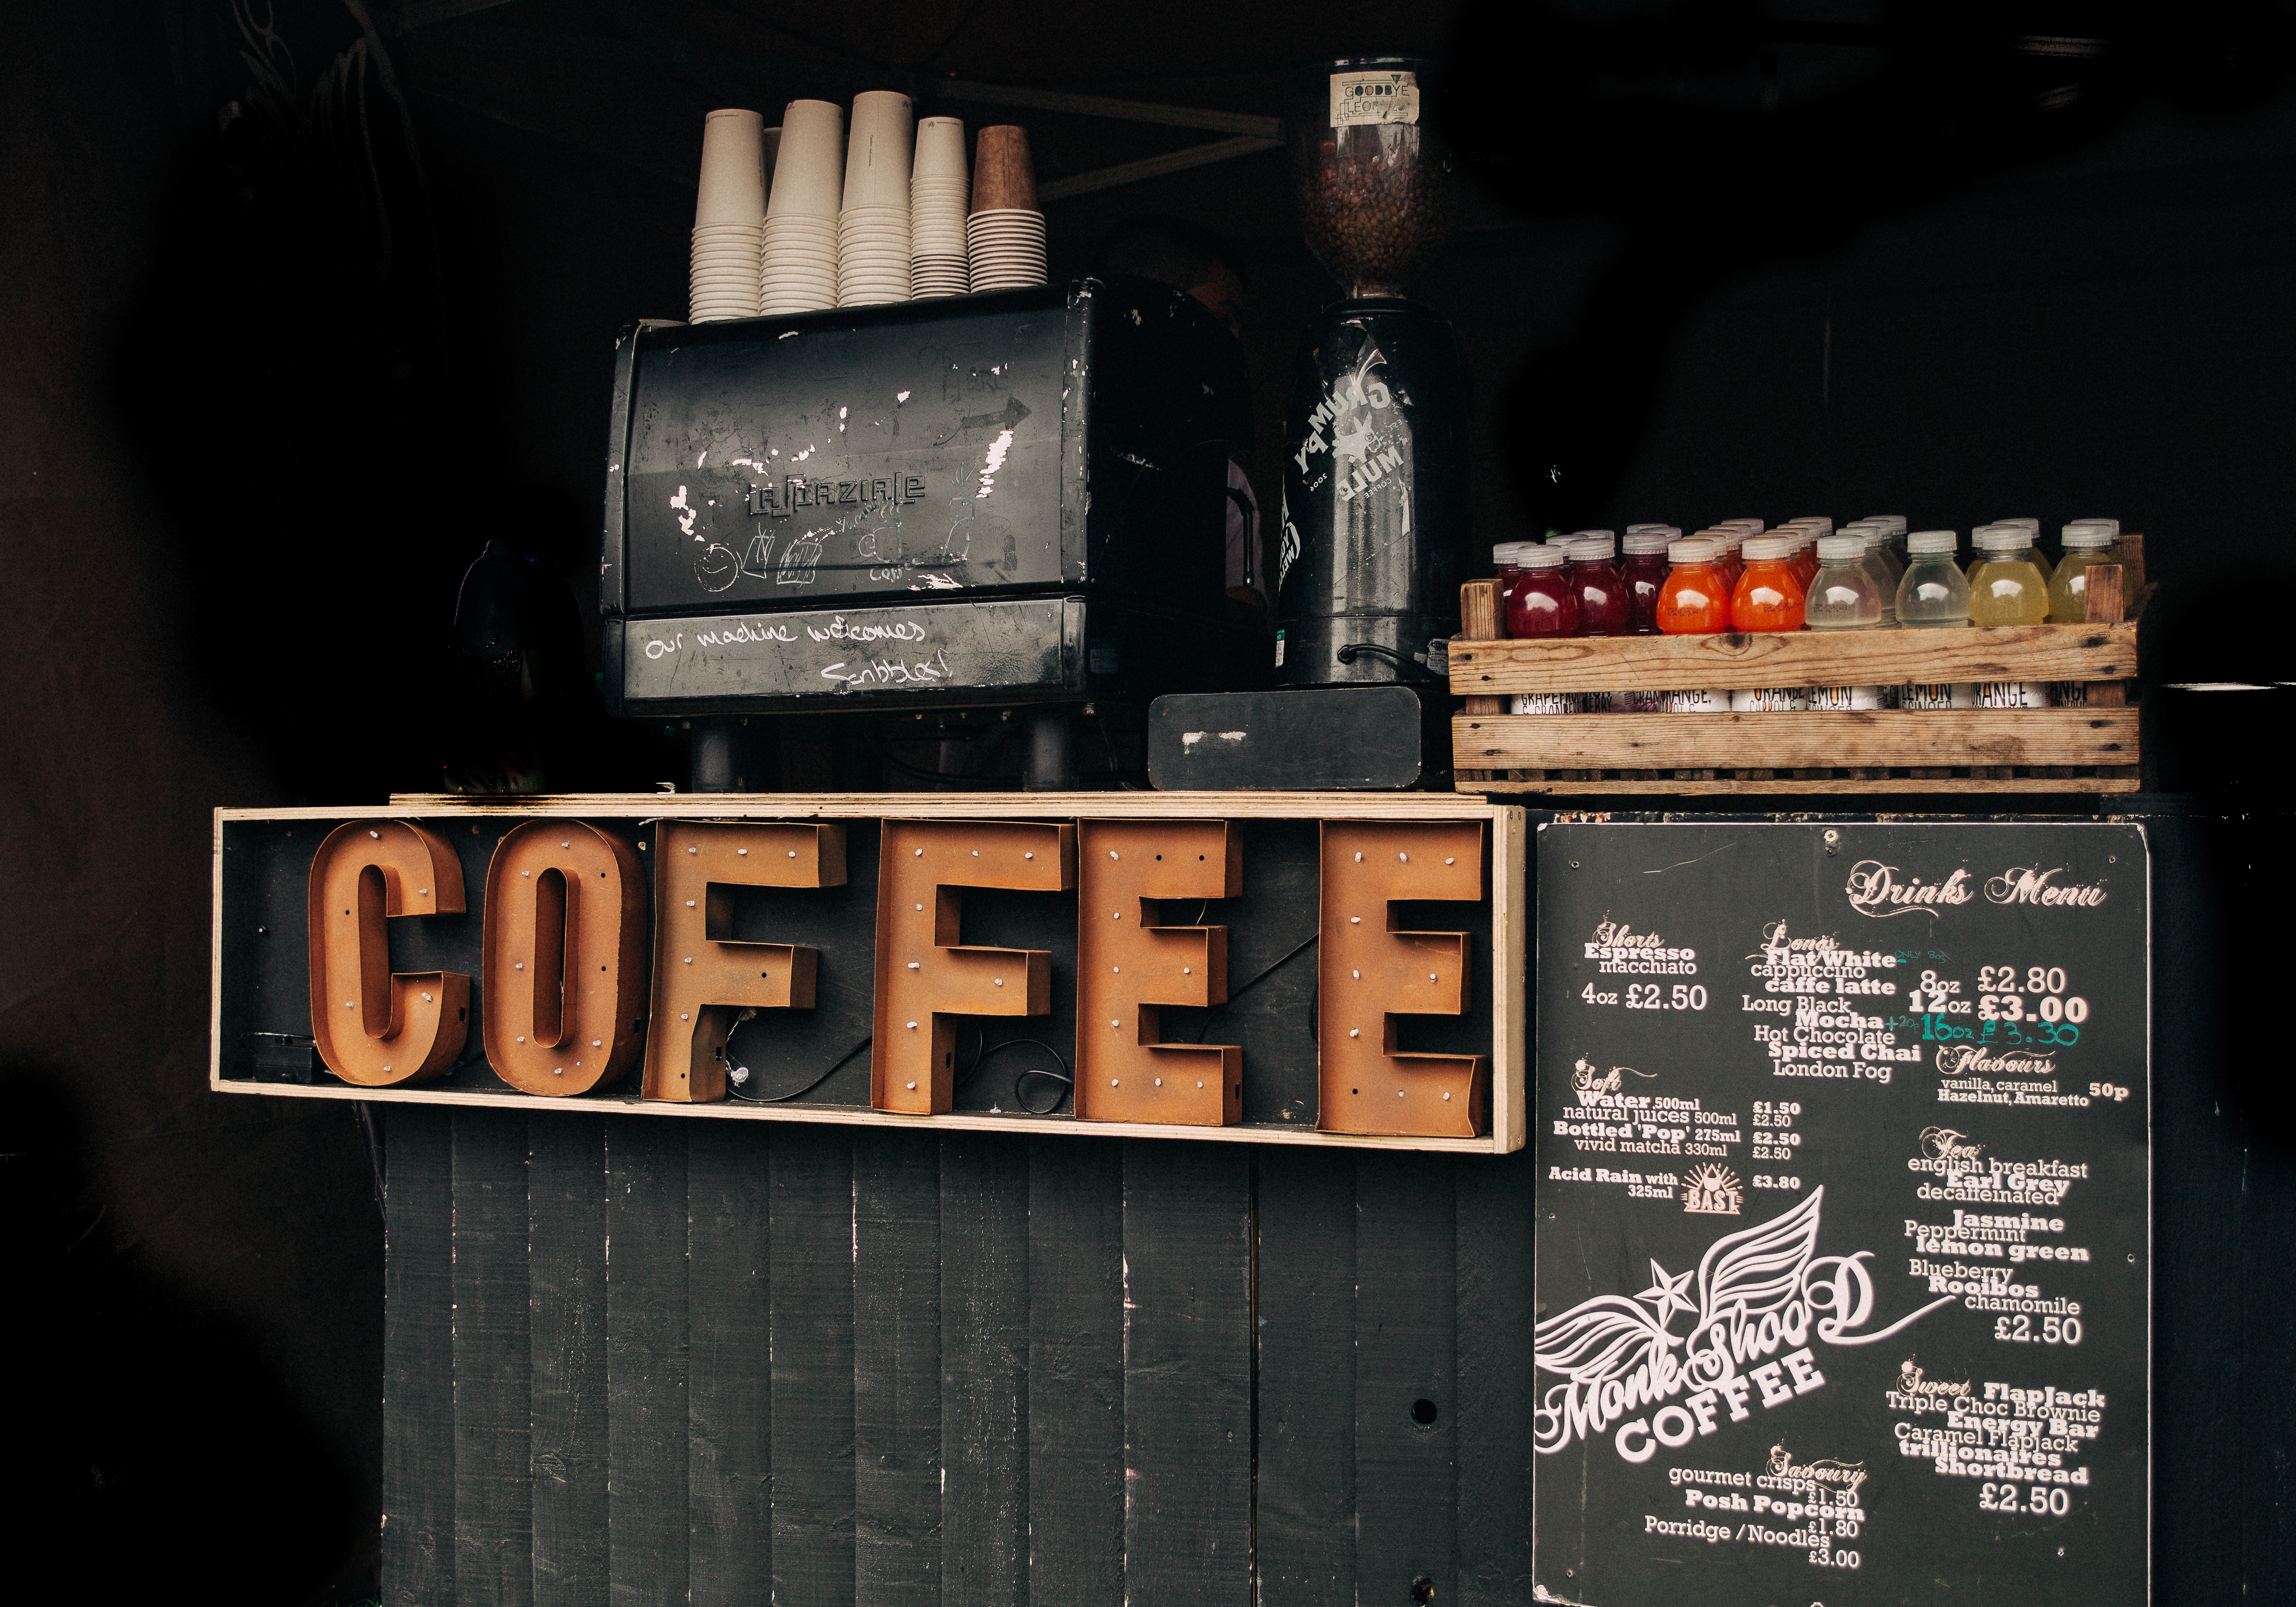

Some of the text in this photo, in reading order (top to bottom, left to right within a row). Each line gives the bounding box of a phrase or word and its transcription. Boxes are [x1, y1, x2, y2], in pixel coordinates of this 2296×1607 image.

[697, 622, 798, 647] machine
[807, 616, 926, 642] welcomes
[1845, 860, 2108, 916] Drinks Menu
[1592, 916, 1665, 948] Shorts
[1584, 943, 1695, 963] Espresso
[1599, 957, 1697, 974] macchiato
[1766, 950, 1898, 968] Flat White
[1895, 950, 1920, 959] ONLY
[309, 817, 1489, 1138] COFFEE
[1750, 964, 1866, 981] cappuccino
[1920, 966, 2066, 994] 8oz £2.80
[1581, 982, 1707, 1010] 4oz £2.50
[1765, 977, 1896, 995] caffe latte
[1742, 995, 1852, 1016] Long Black
[1909, 990, 2088, 1023] 12oz £3.00
[1795, 1010, 1884, 1029] Mocha
[1921, 1014, 1975, 1040] 16oz
[1754, 1025, 1895, 1045] Hot Chocolate
[1768, 1041, 1921, 1062] Spiced Chai
[1936, 1045, 2056, 1075] Flavours
[1571, 1059, 1642, 1096] Soft
[1773, 1060, 1892, 1084] London Fog
[1941, 1077, 2057, 1093] vanilla, caramel
[1577, 1090, 1802, 1115] Water 500ml £1.50
[1937, 1089, 2089, 1106] Hazelnut, Amaretto
[2089, 1083, 2128, 1100] 50p
[1563, 1105, 1791, 1127] natural juices 500ml £2.50
[1553, 1121, 1633, 1138] Bottled
[1695, 1128, 1741, 1142] 275ml
[1752, 1132, 1801, 1146] £2.50
[1919, 1126, 1984, 1160] Tea
[1574, 1137, 1791, 1160] vivid matcha 330ml £2.50
[1908, 1156, 2088, 1178] english breakfast
[1548, 1167, 1801, 1210] Acid Rain with BAST £3.80
[1628, 1185, 1674, 1199] 325ml
[1917, 1182, 2059, 1205] decaffeinated
[1947, 1170, 2070, 1197] Earl Grey
[1904, 1220, 2026, 1242] Peppermint
[1953, 1209, 2064, 1231] Jasmine
[1916, 1235, 2089, 1262] lemon green
[1909, 1259, 2013, 1283] Blueberry
[1928, 1275, 2039, 1298] Rooibos
[1964, 1293, 2080, 1315] chamomile
[1994, 1315, 2081, 1344] £2.50
[1896, 1360, 1971, 1396] Sweet
[1614, 1347, 1826, 1463] COFFEE
[1886, 1390, 2100, 1422] Triple Choc Brownie
[1894, 1422, 2079, 1453] Caramel Flapjack
[1947, 1411, 2099, 1438] Energy Bar
[1899, 1439, 2061, 1466] trillionaires
[1766, 1445, 1867, 1493] Savoury
[1935, 1456, 2088, 1485] Shortbread
[1669, 1467, 1858, 1507] gourmet crisps £1.50
[1979, 1482, 2068, 1515] £2.50
[1685, 1489, 1865, 1538] Posh Popcorn £1.80
[1645, 1516, 1731, 1542] Porridge
[1809, 1548, 1859, 1568] £3.00
